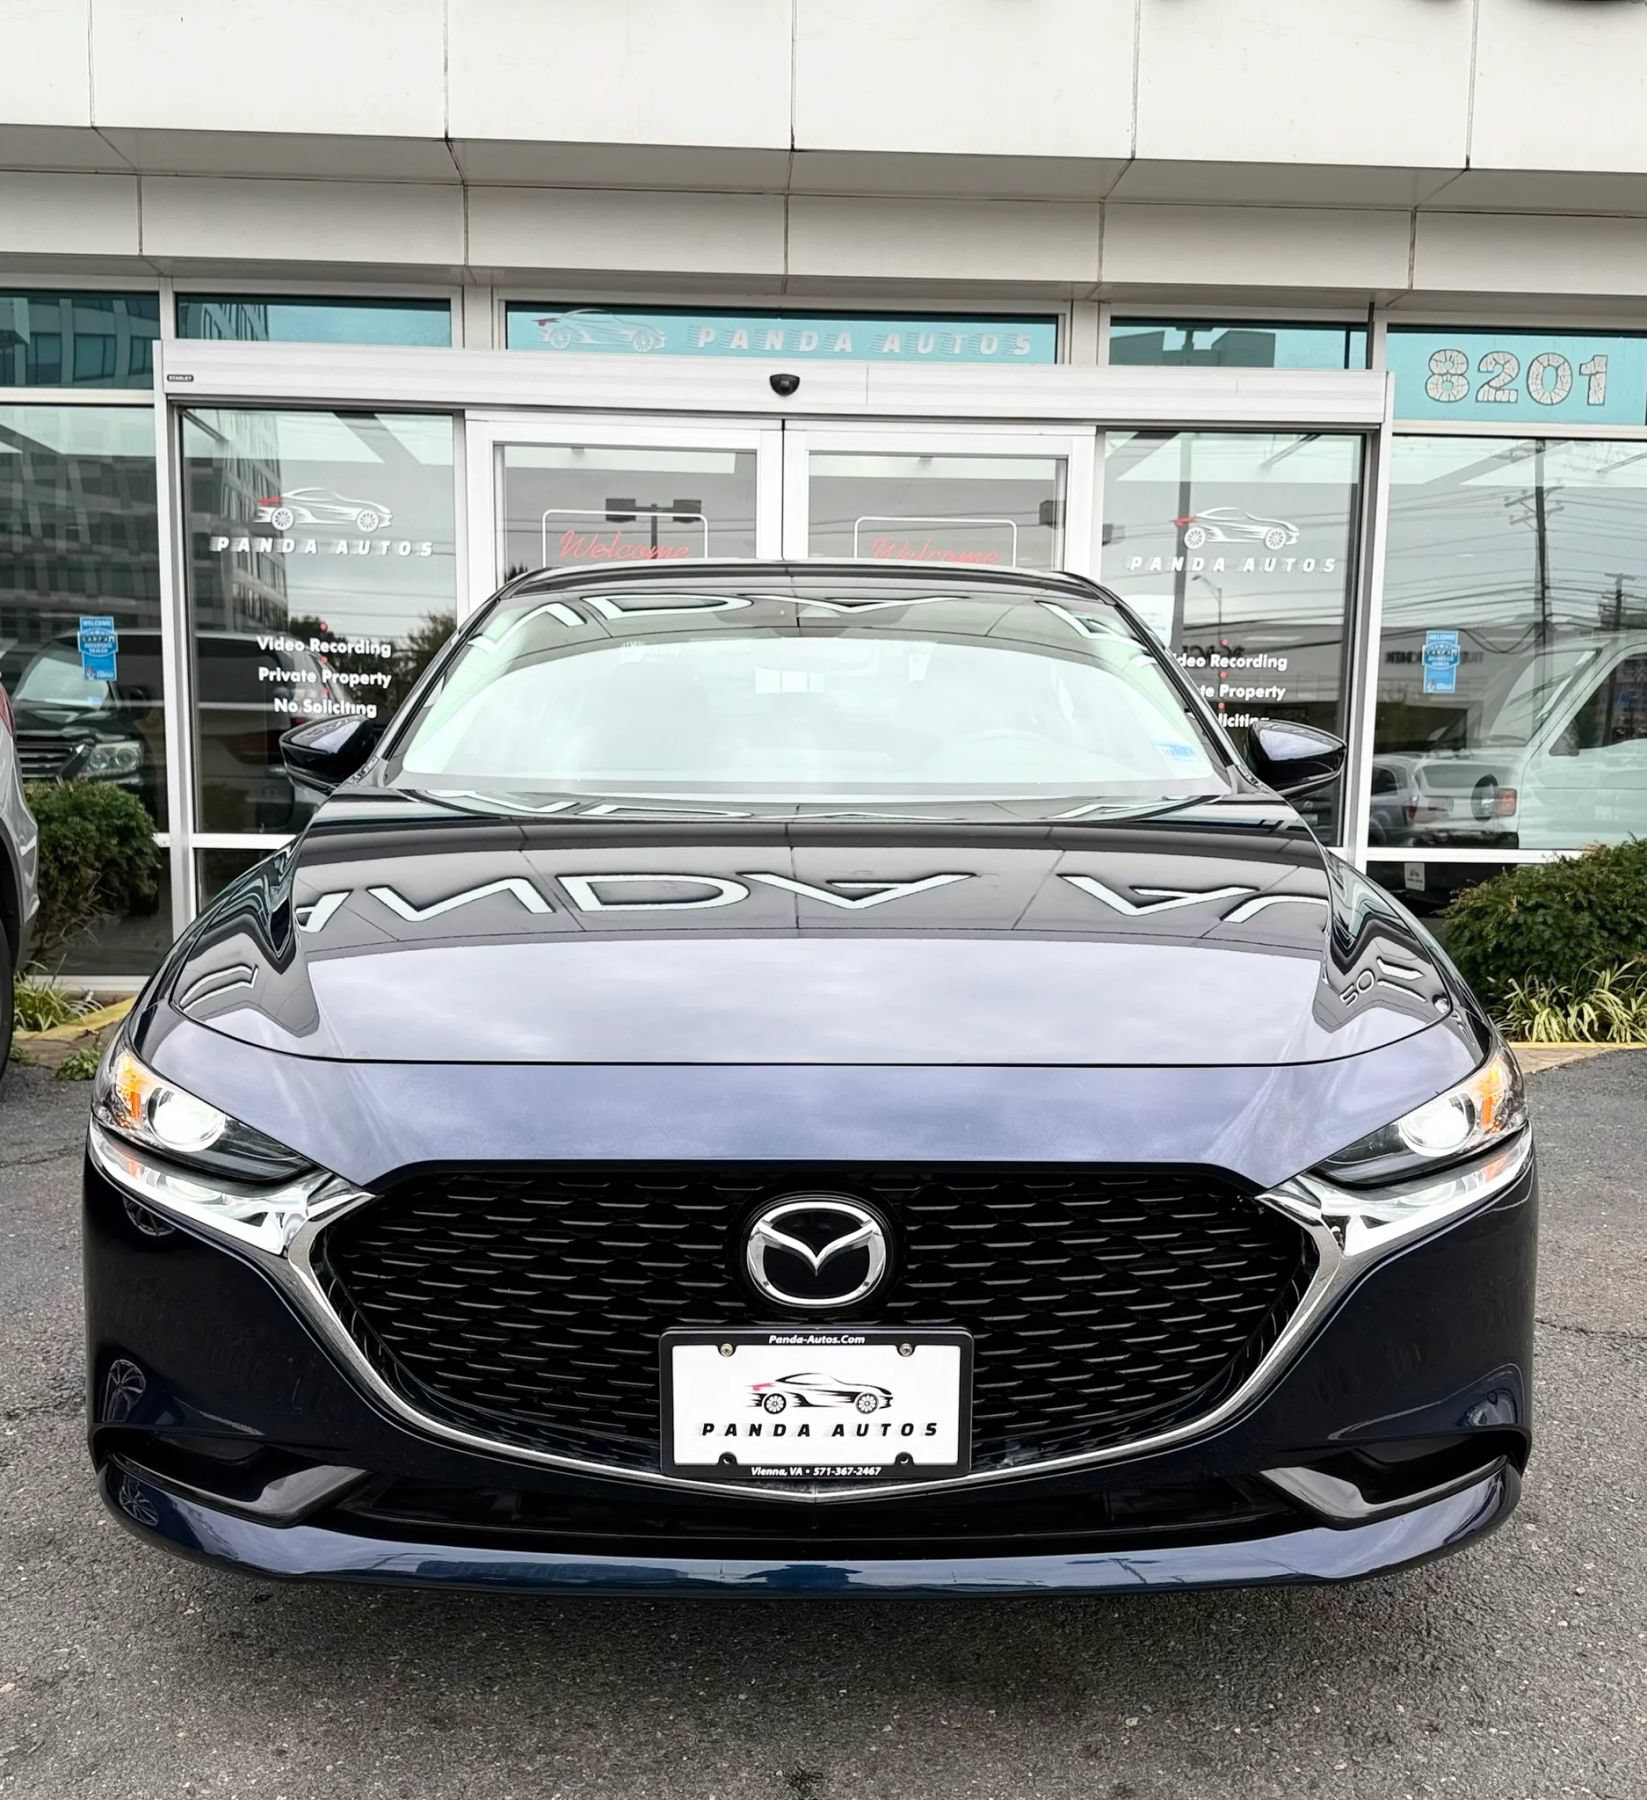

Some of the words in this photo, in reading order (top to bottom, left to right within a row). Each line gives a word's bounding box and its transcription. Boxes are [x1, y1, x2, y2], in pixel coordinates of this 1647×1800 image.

[695, 326, 852, 352] PANDA
[880, 332, 1032, 355] AUTOS
[1425, 348, 1608, 406] 8201
[216, 536, 318, 554] PANDA
[335, 539, 432, 556] AUTOS
[559, 529, 689, 559] Welcome
[1129, 556, 1225, 572] PANDA
[1242, 557, 1336, 573] AUTOS
[256, 635, 305, 652] Video
[310, 637, 391, 658] Recording
[1210, 653, 1288, 671] Recording
[258, 667, 317, 683] Private
[322, 669, 392, 688] Property
[1219, 684, 1286, 701] Property
[274, 698, 299, 713] No
[303, 699, 377, 718] Soliciting
[768, 1334, 866, 1344] Panda-Autos.Com
[701, 1422, 811, 1437] PANDA
[831, 1422, 938, 1437] AUTOS
[751, 1466, 788, 1476] Vienna,
[790, 1467, 803, 1475] VA
[813, 1467, 881, 1476] 571-367-2467
